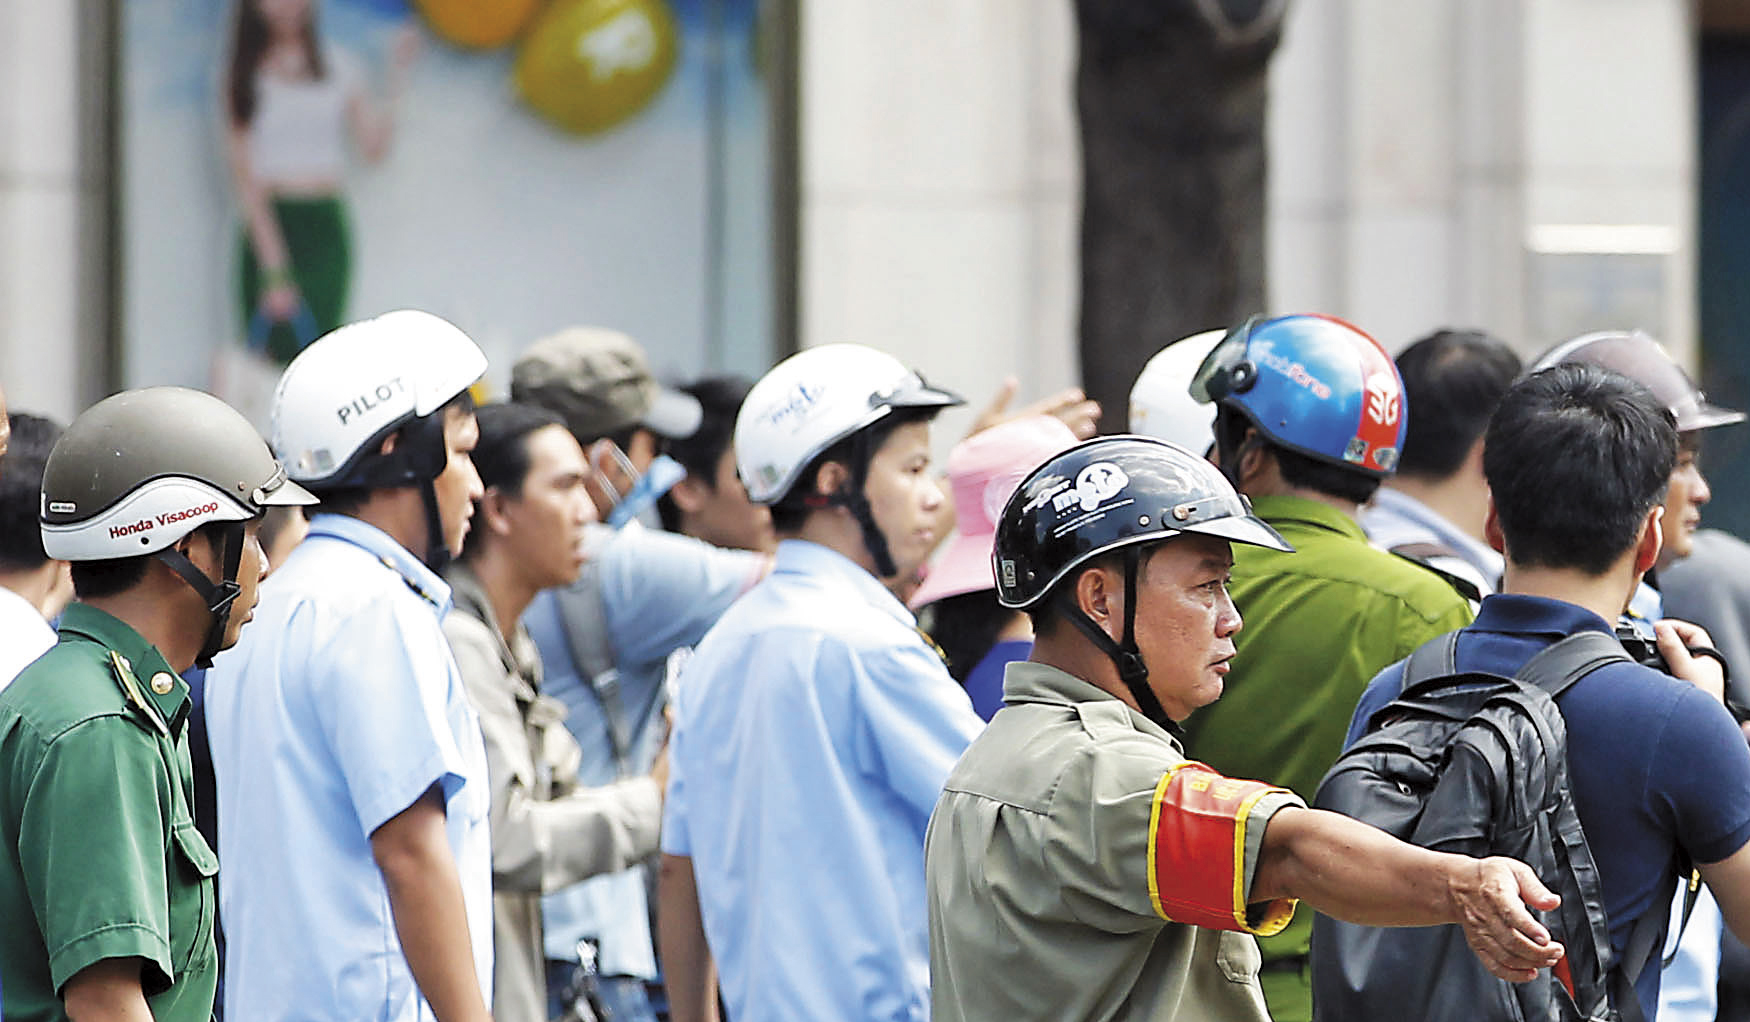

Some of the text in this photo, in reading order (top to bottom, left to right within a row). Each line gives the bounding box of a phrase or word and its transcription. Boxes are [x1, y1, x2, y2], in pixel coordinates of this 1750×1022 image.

[337, 376, 405, 425] PILOT
[109, 501, 219, 539] Honda Visacoop
